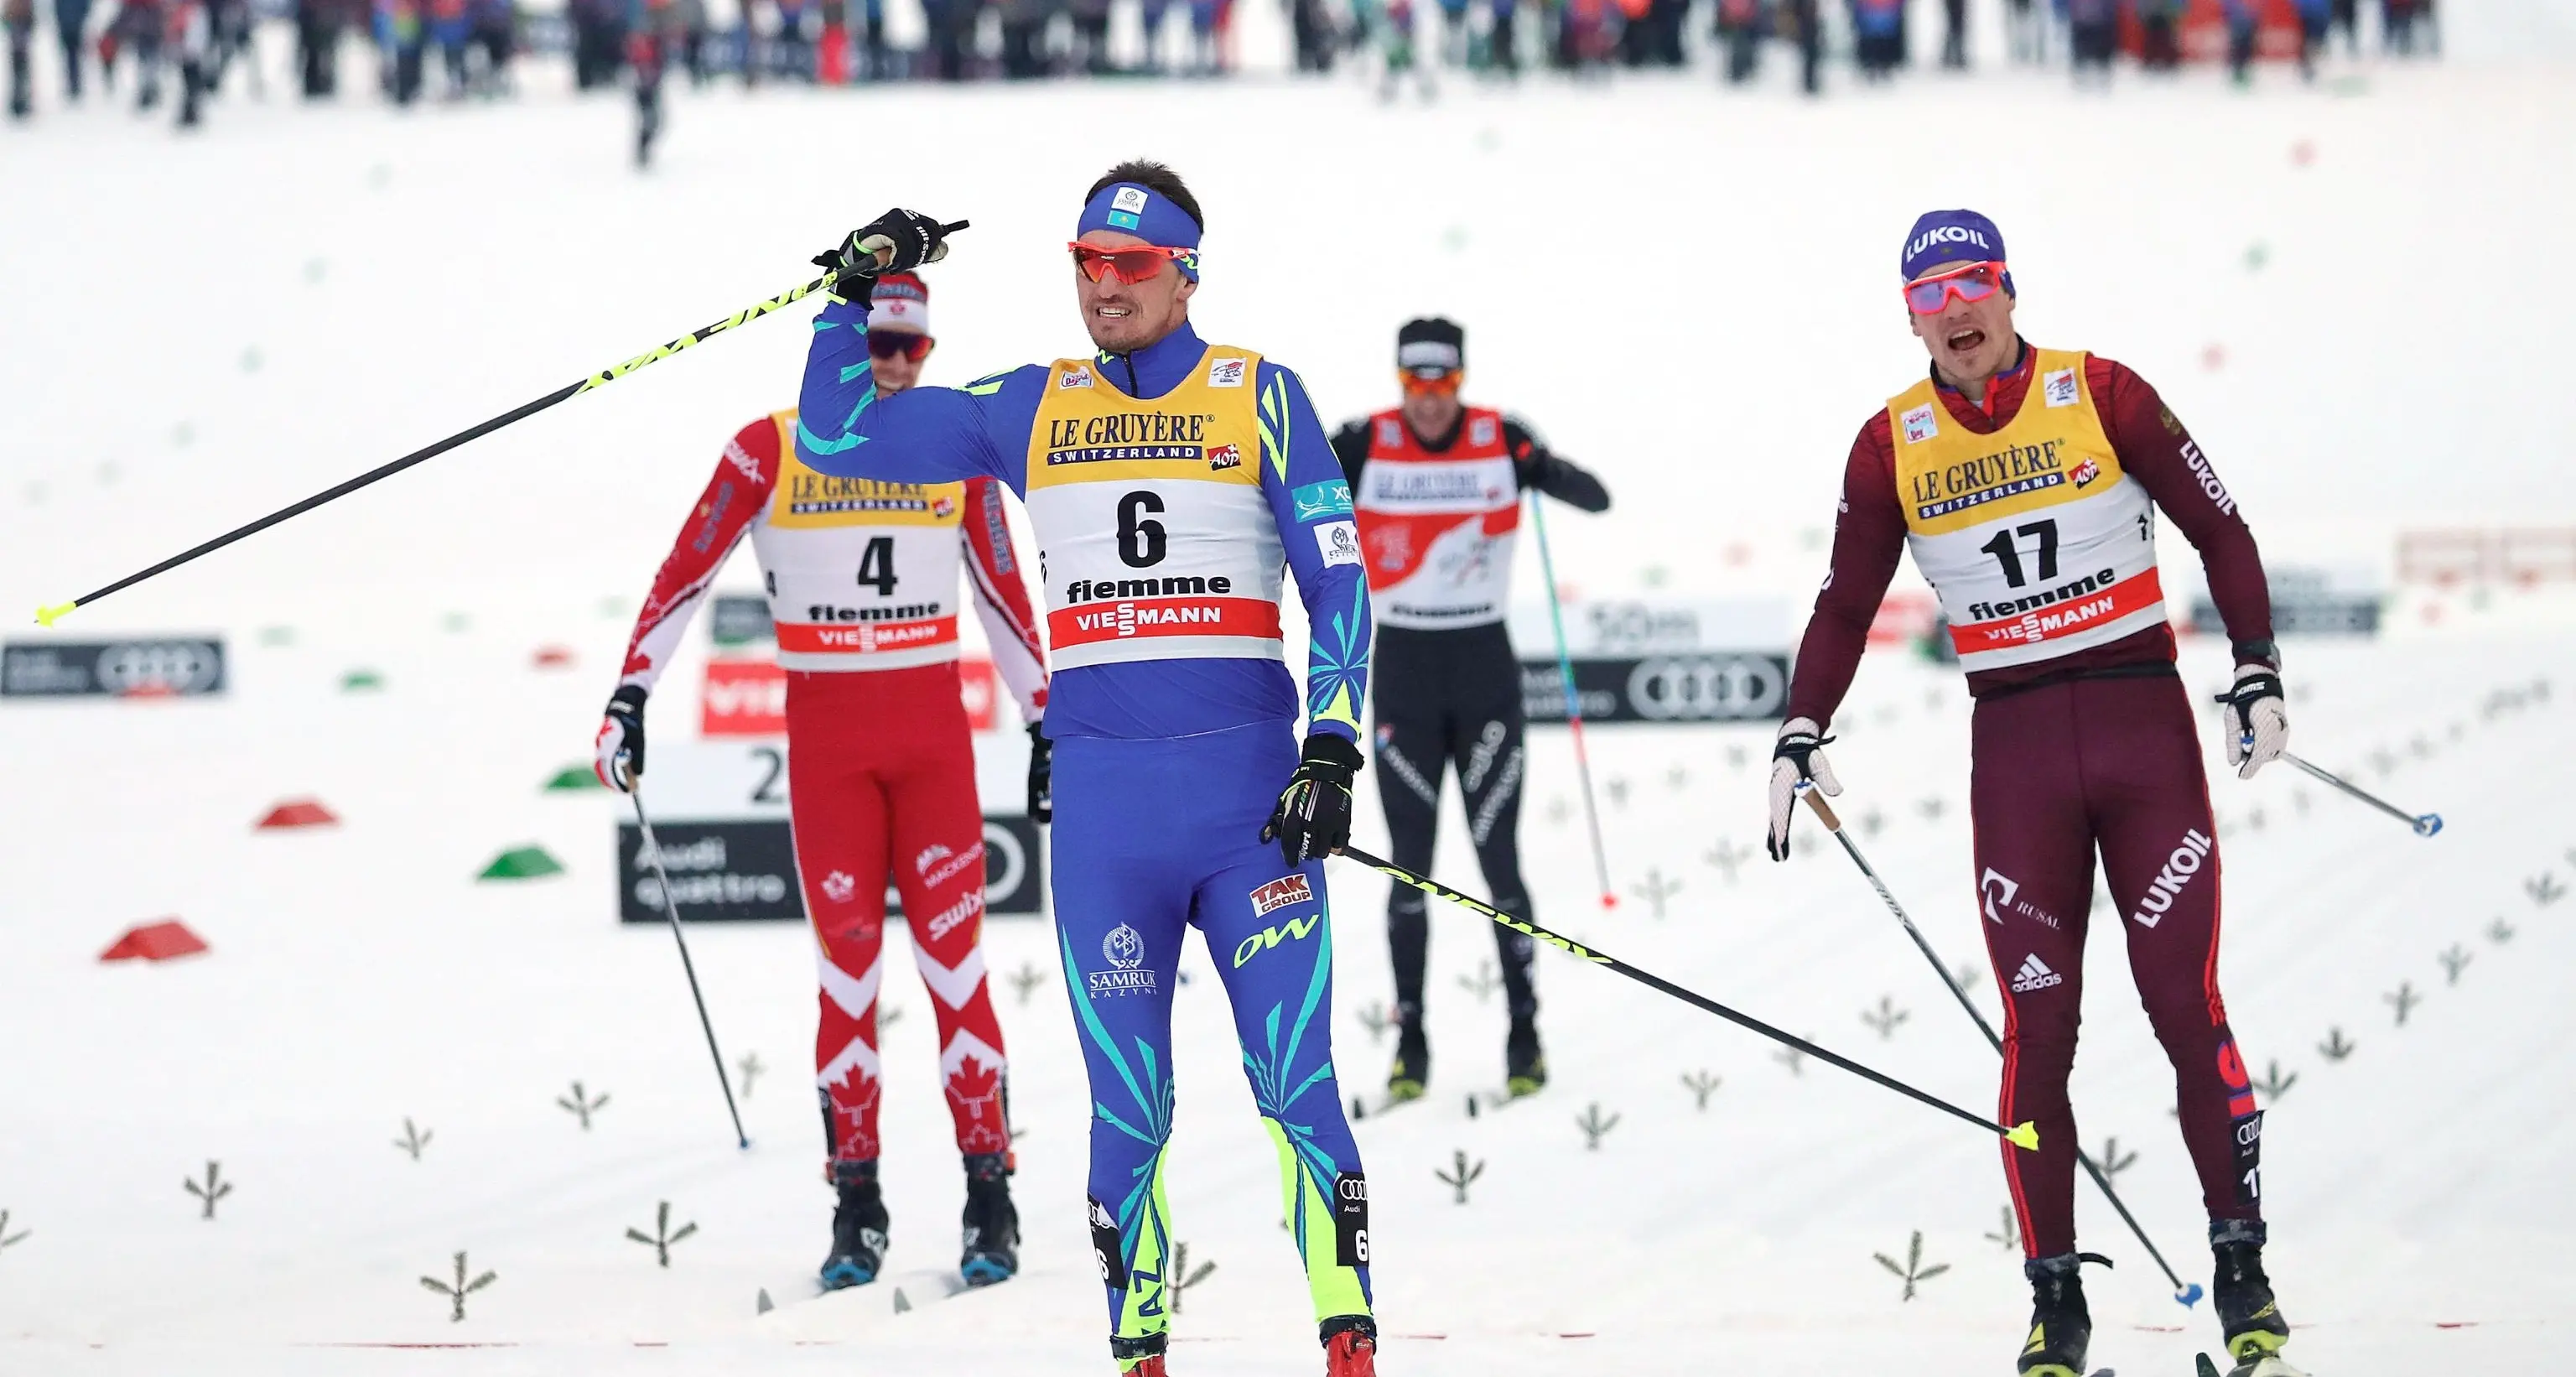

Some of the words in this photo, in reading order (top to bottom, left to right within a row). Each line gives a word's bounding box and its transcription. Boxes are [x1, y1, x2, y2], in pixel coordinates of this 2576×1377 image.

[1906, 226, 1989, 262] LUKOIL
[1049, 419, 1079, 448] LE
[1085, 411, 1204, 444] GRUYÈRE
[1053, 447, 1196, 463] SWITZERLAND
[1209, 453, 1240, 466] AOP
[1914, 470, 1941, 503] LE
[1946, 440, 2061, 494] GRUYÈRE
[792, 475, 817, 498] LE
[2180, 440, 2237, 516] LUKOIL
[1921, 475, 2059, 518] SWITZERLAND
[1116, 491, 1166, 568] 6
[858, 537, 897, 595] 4
[1981, 518, 2059, 588] 17
[1067, 575, 1231, 603] fiemme
[1968, 568, 2115, 621] fiemme
[809, 601, 940, 621] fiemme
[1077, 603, 1221, 636] VIESSMANN
[1985, 595, 2114, 642] VIESSMANN
[634, 836, 726, 872] Audi
[635, 872, 787, 912] quattro
[1252, 875, 1310, 905] TAK
[2134, 829, 2212, 929] LUKOIL
[928, 886, 984, 942] swix
[1261, 891, 1311, 913] GROUP
[2016, 901, 2061, 930] RUSAL
[1234, 915, 1319, 969] OW
[1089, 971, 1156, 988] SAMRUK
[2012, 973, 2062, 993] adidas
[2243, 1164, 2260, 1198] 1
[1344, 1204, 1360, 1213] Audi
[1355, 1229, 1368, 1261] 6
[1095, 1248, 1109, 1281] 6
